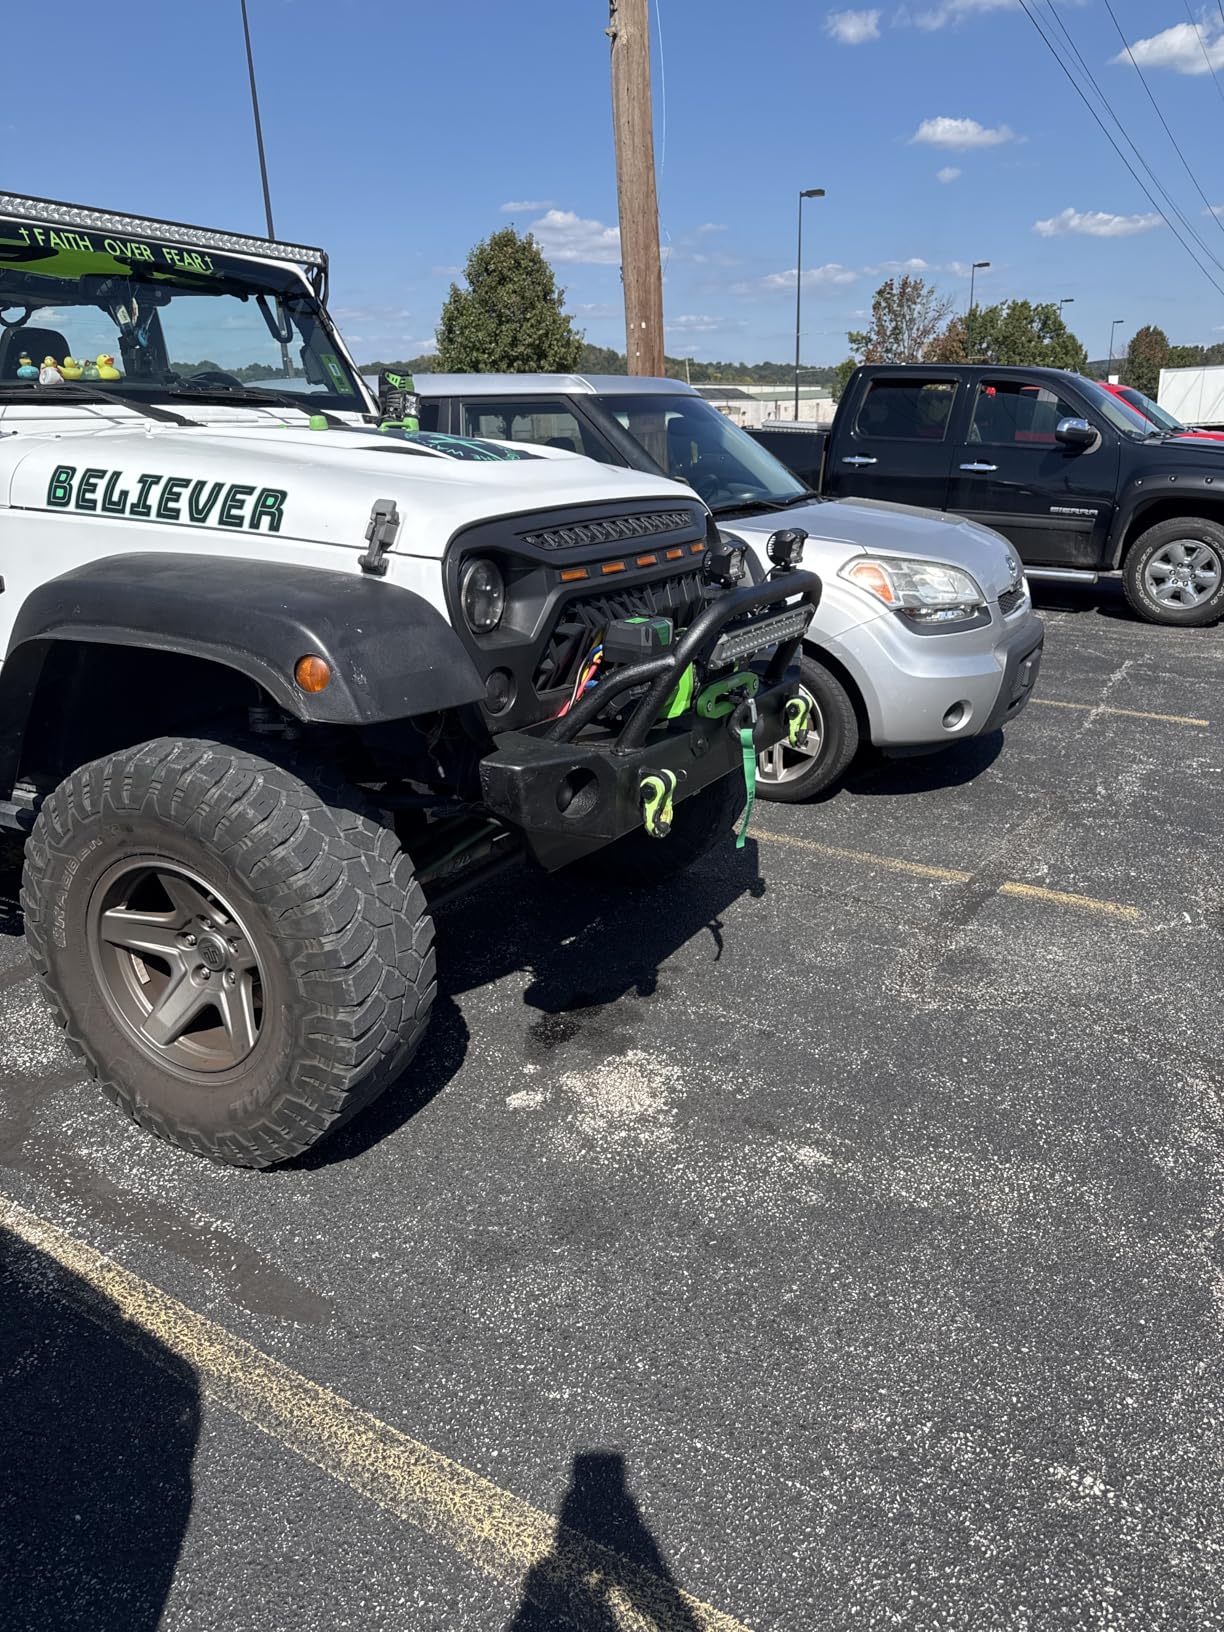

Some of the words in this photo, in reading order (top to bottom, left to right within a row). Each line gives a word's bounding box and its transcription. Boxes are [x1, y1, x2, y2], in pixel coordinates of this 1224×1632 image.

[33, 227, 94, 252] FAITH
[104, 239, 155, 262] OVER
[162, 247, 206, 270] FEAR
[47, 465, 288, 533] BELIEVER
